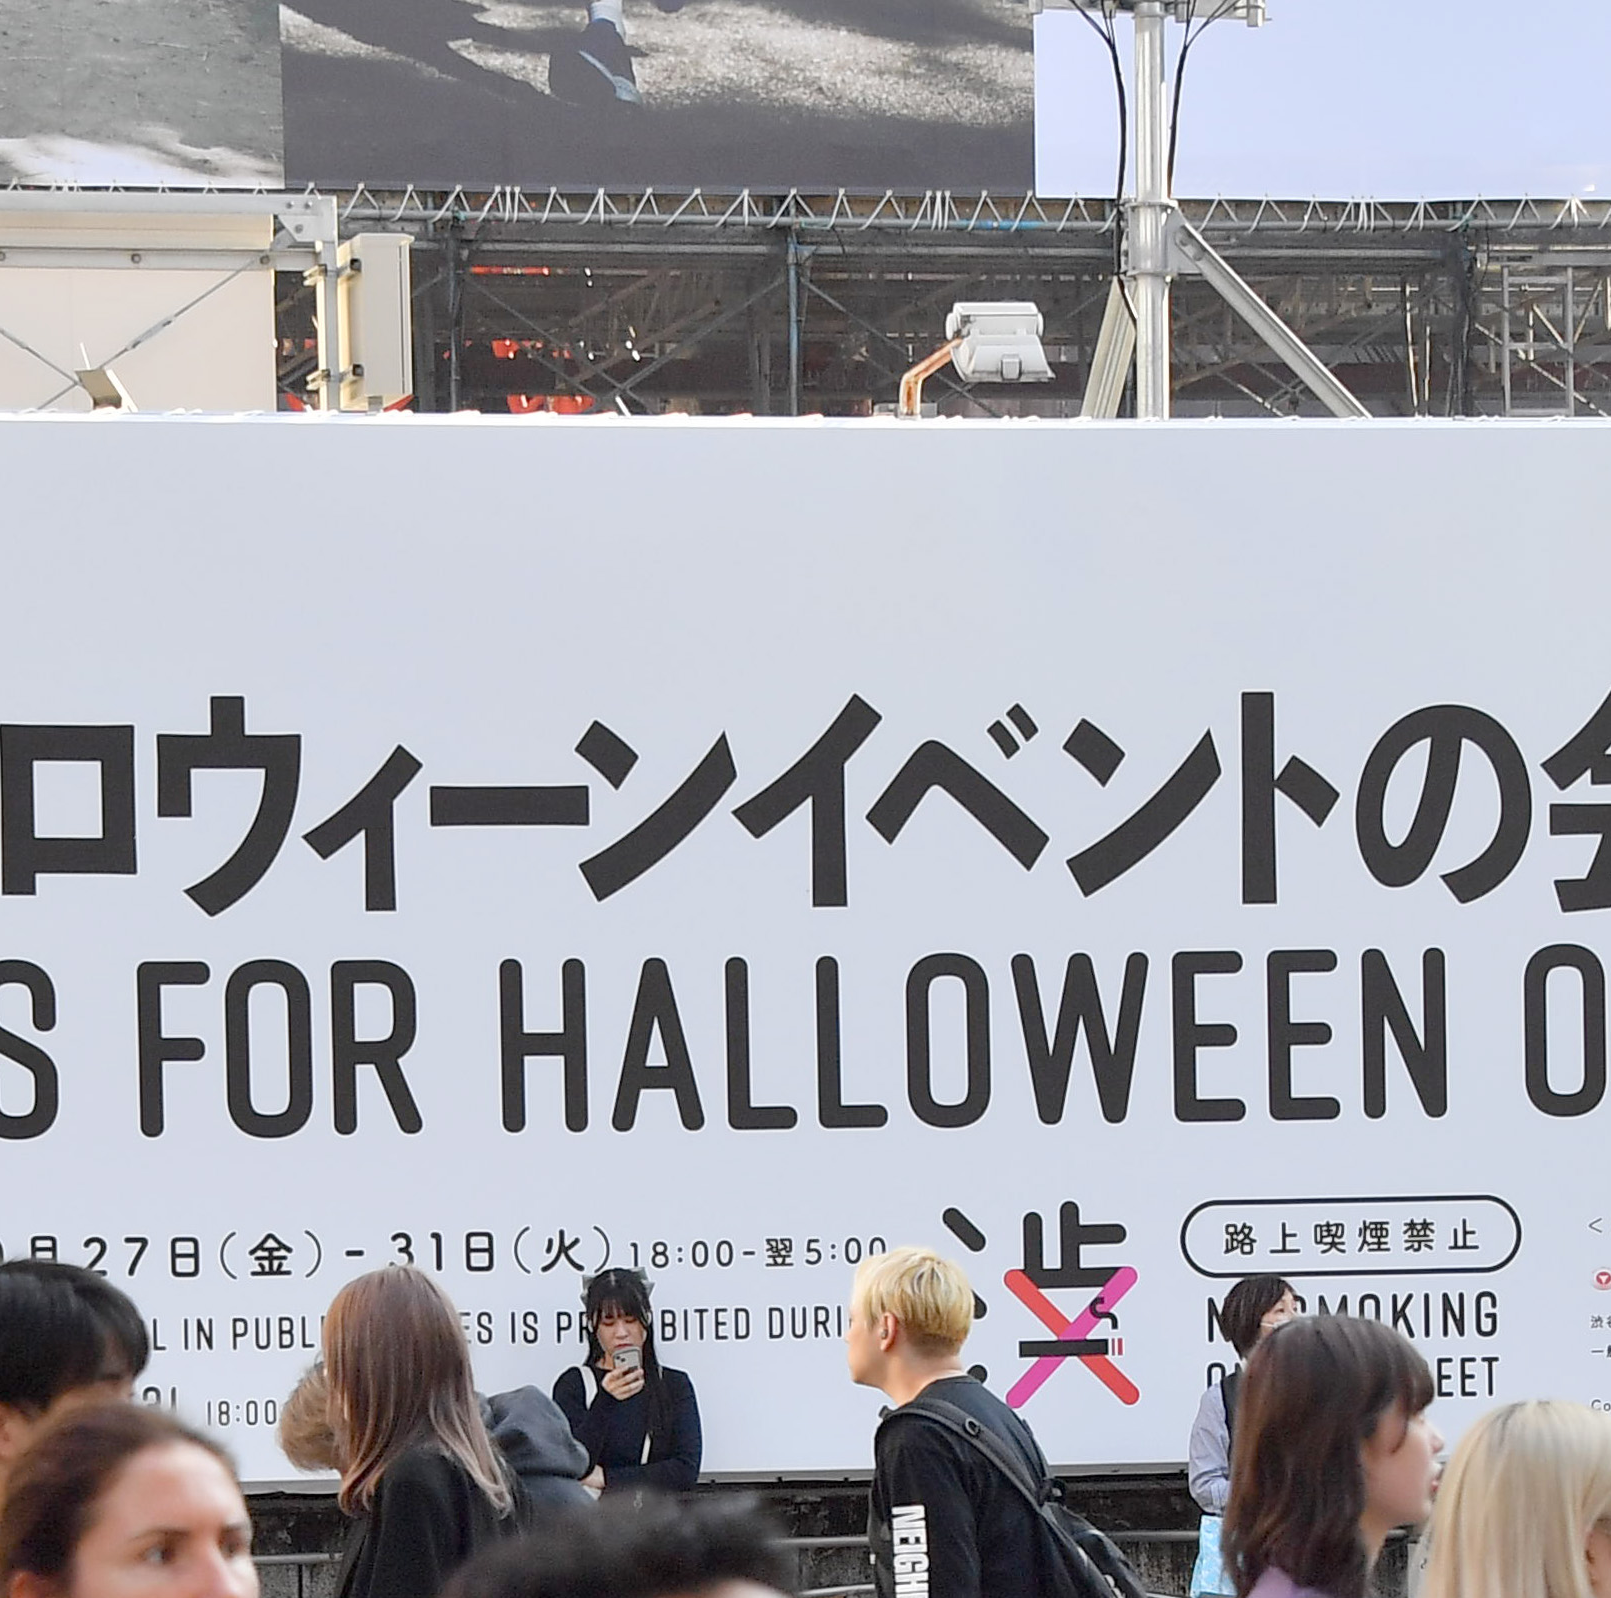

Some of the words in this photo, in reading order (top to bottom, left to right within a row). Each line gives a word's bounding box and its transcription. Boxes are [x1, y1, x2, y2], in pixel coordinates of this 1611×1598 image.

[136, 957, 424, 1138] FOR
[499, 947, 1447, 1133] HALLOWEEN
[1223, 1217, 1480, 1257] 路上喫煙禁止
[183, 1317, 213, 1351] IN
[510, 1311, 539, 1344] IS
[768, 1305, 842, 1340] DURI
